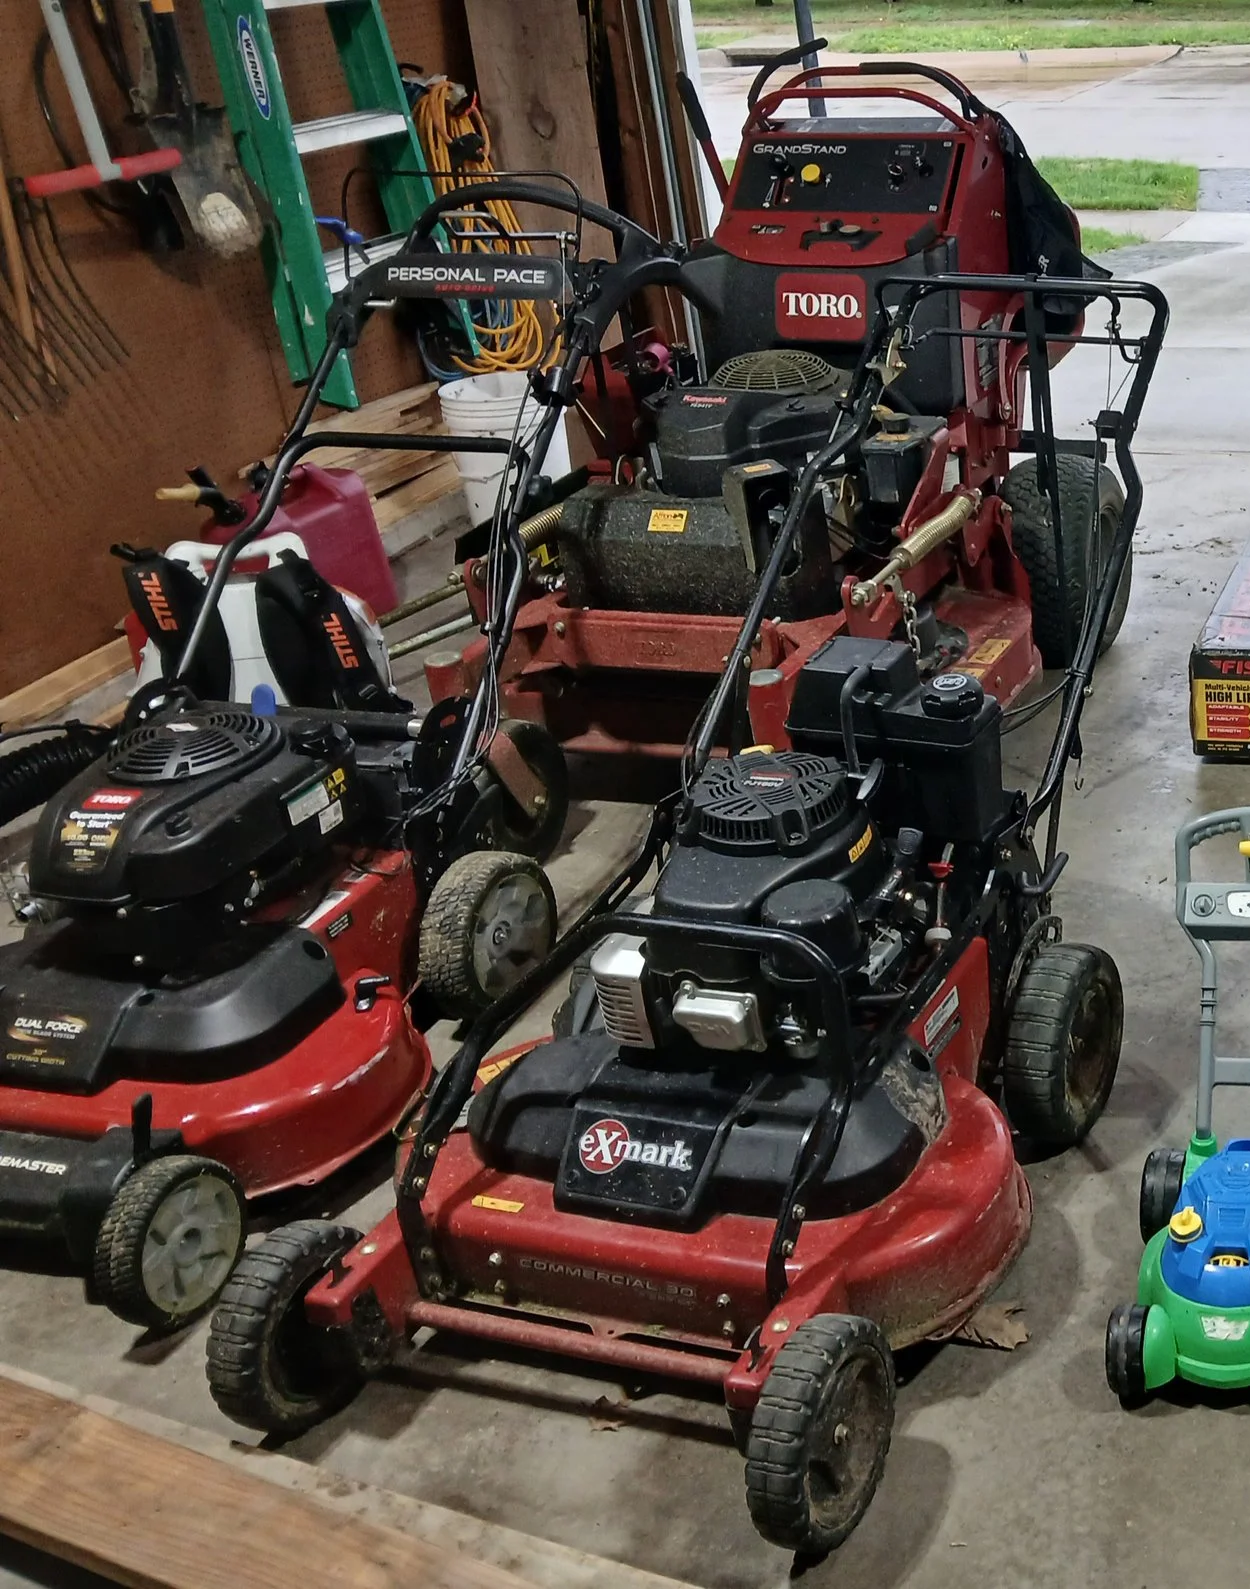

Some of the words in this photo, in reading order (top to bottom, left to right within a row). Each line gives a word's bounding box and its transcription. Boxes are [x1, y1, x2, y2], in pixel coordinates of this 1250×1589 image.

[243, 38, 266, 99] WERNER
[388, 267, 486, 282] PERSONAL
[493, 268, 545, 284] PACE
[782, 292, 859, 318] TORO
[141, 572, 179, 632] STIHL
[323, 612, 359, 669] STIHL
[1205, 691, 1229, 703] HIGH
[92, 794, 132, 804] TORO
[69, 811, 126, 820] Guaranteed
[76, 820, 86, 828] to
[87, 820, 110, 829] Start
[14, 1017, 43, 1029] DUAL
[45, 1020, 84, 1034] FORCE
[6, 1053, 40, 1063] CUTTING
[580, 1127, 692, 1172] eXmark
[0, 1155, 66, 1176] EMASTER
[519, 1257, 658, 1292] COMMERCIAL
